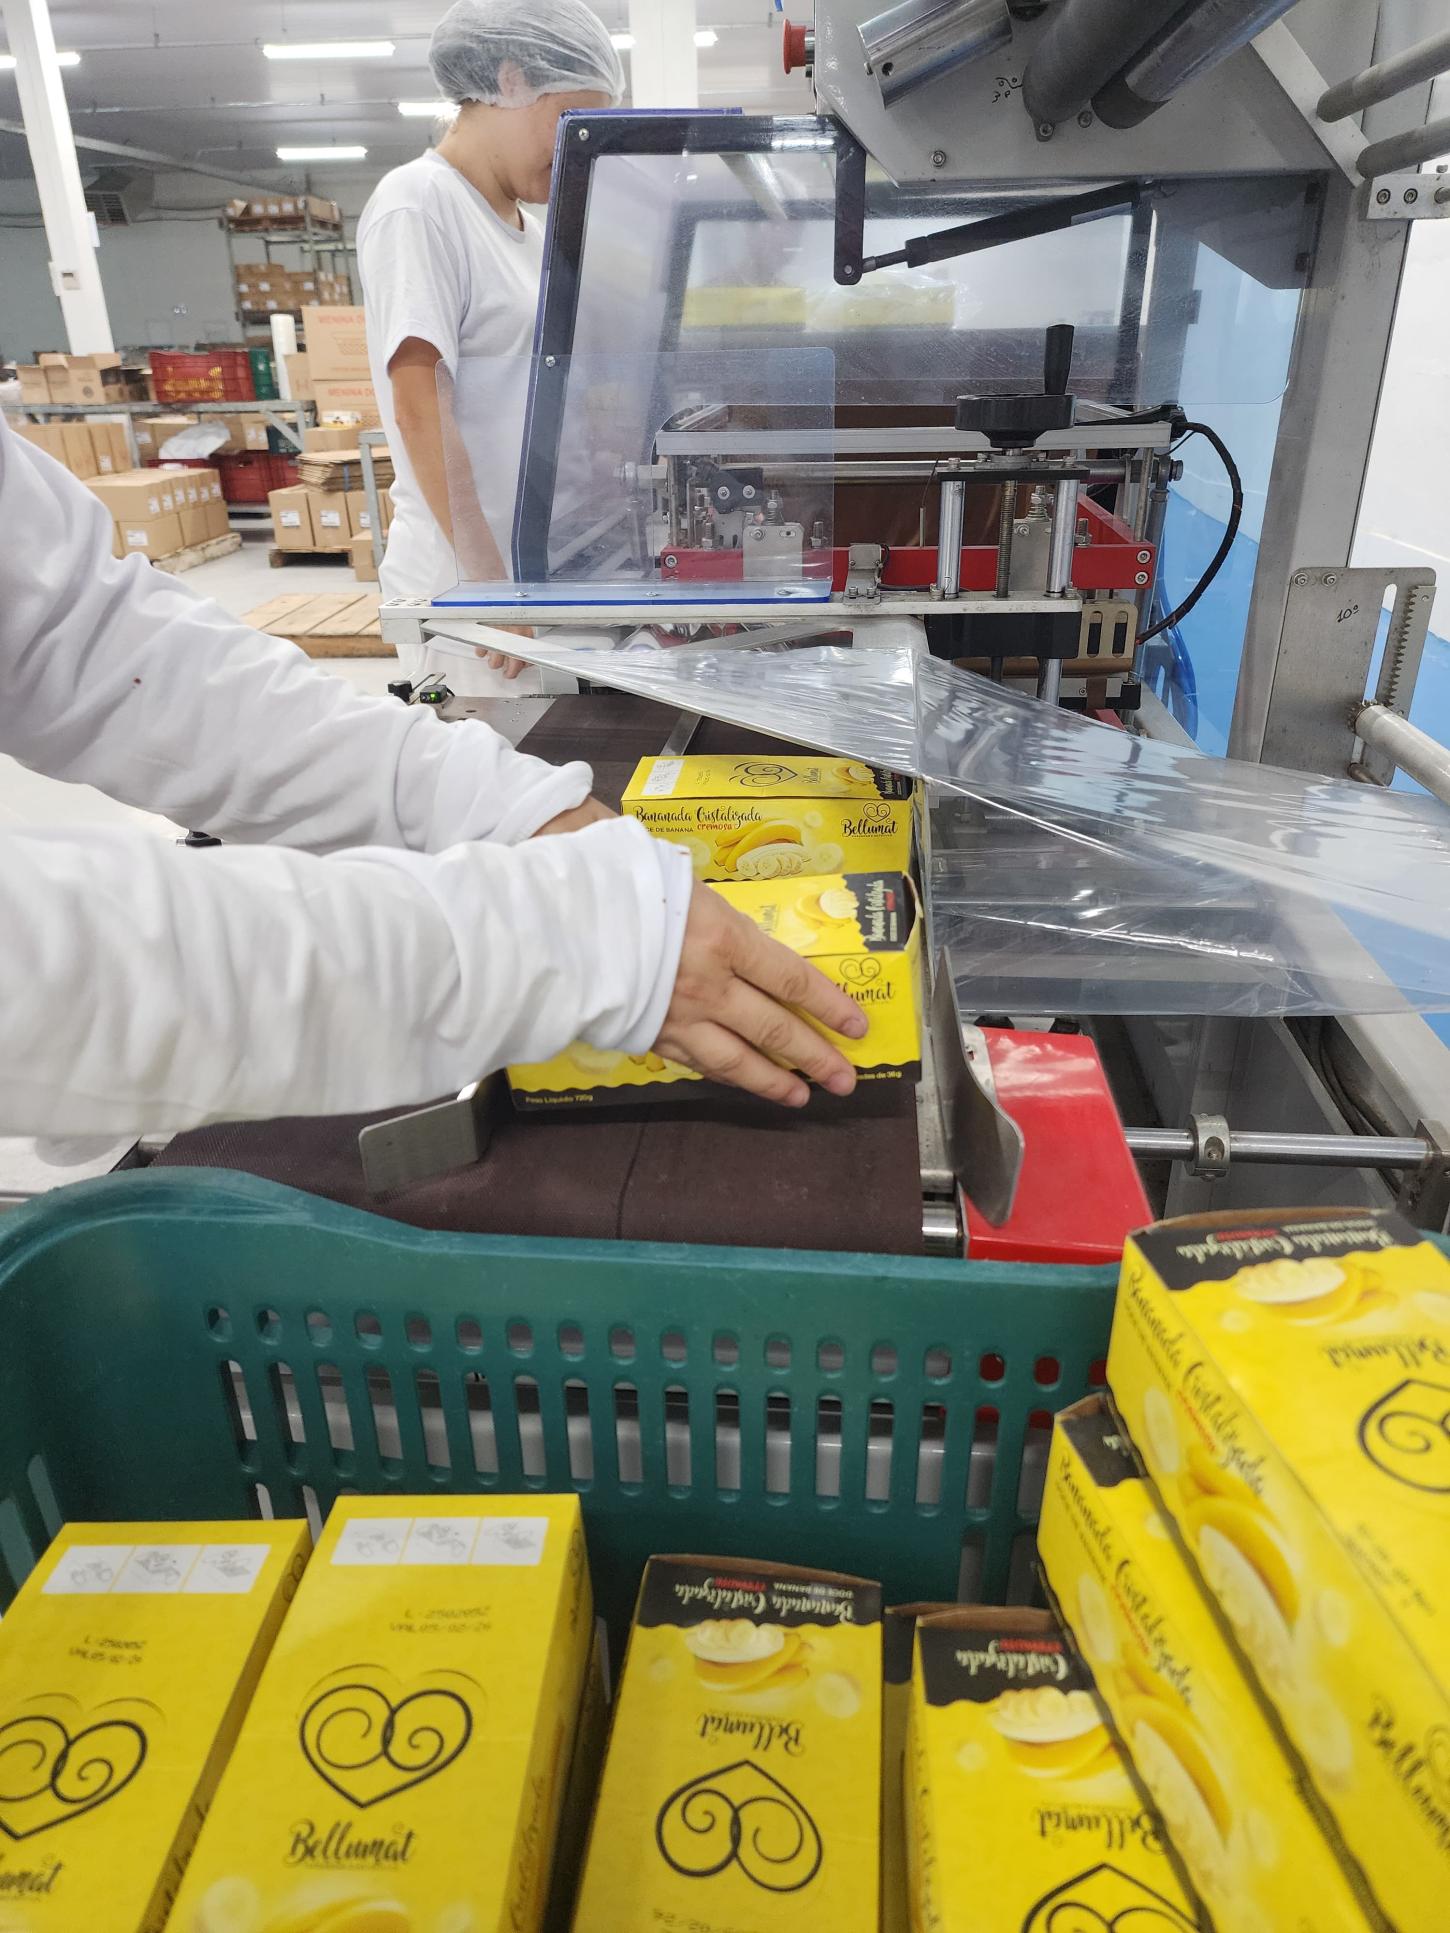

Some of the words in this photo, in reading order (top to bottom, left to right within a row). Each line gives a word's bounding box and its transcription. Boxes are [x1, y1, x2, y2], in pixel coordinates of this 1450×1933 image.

[633, 805, 692, 823] Bananada
[696, 806, 762, 830] Cristalizada
[697, 822, 733, 831] cremosa
[841, 818, 898, 837] Bellumat
[772, 1593, 855, 1625] Bananada
[696, 1713, 804, 1757] Bellumat
[283, 1818, 416, 1868] Bellumat
